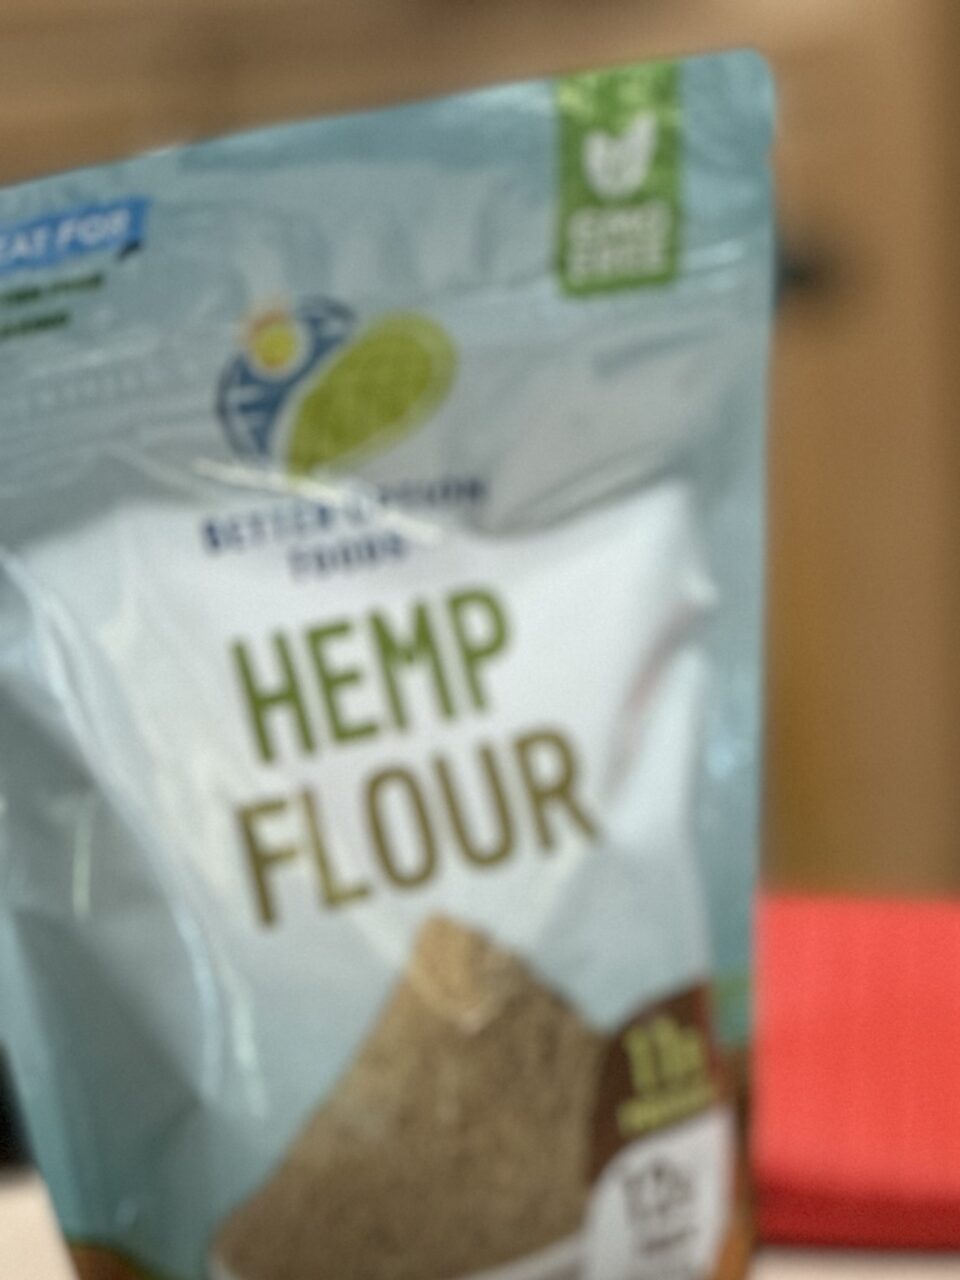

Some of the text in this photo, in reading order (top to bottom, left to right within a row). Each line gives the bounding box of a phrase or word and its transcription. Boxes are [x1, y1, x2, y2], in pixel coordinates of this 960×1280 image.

[56, 208, 131, 250] FOR
[230, 587, 511, 765] HEMP
[236, 727, 599, 930] FLOUR
